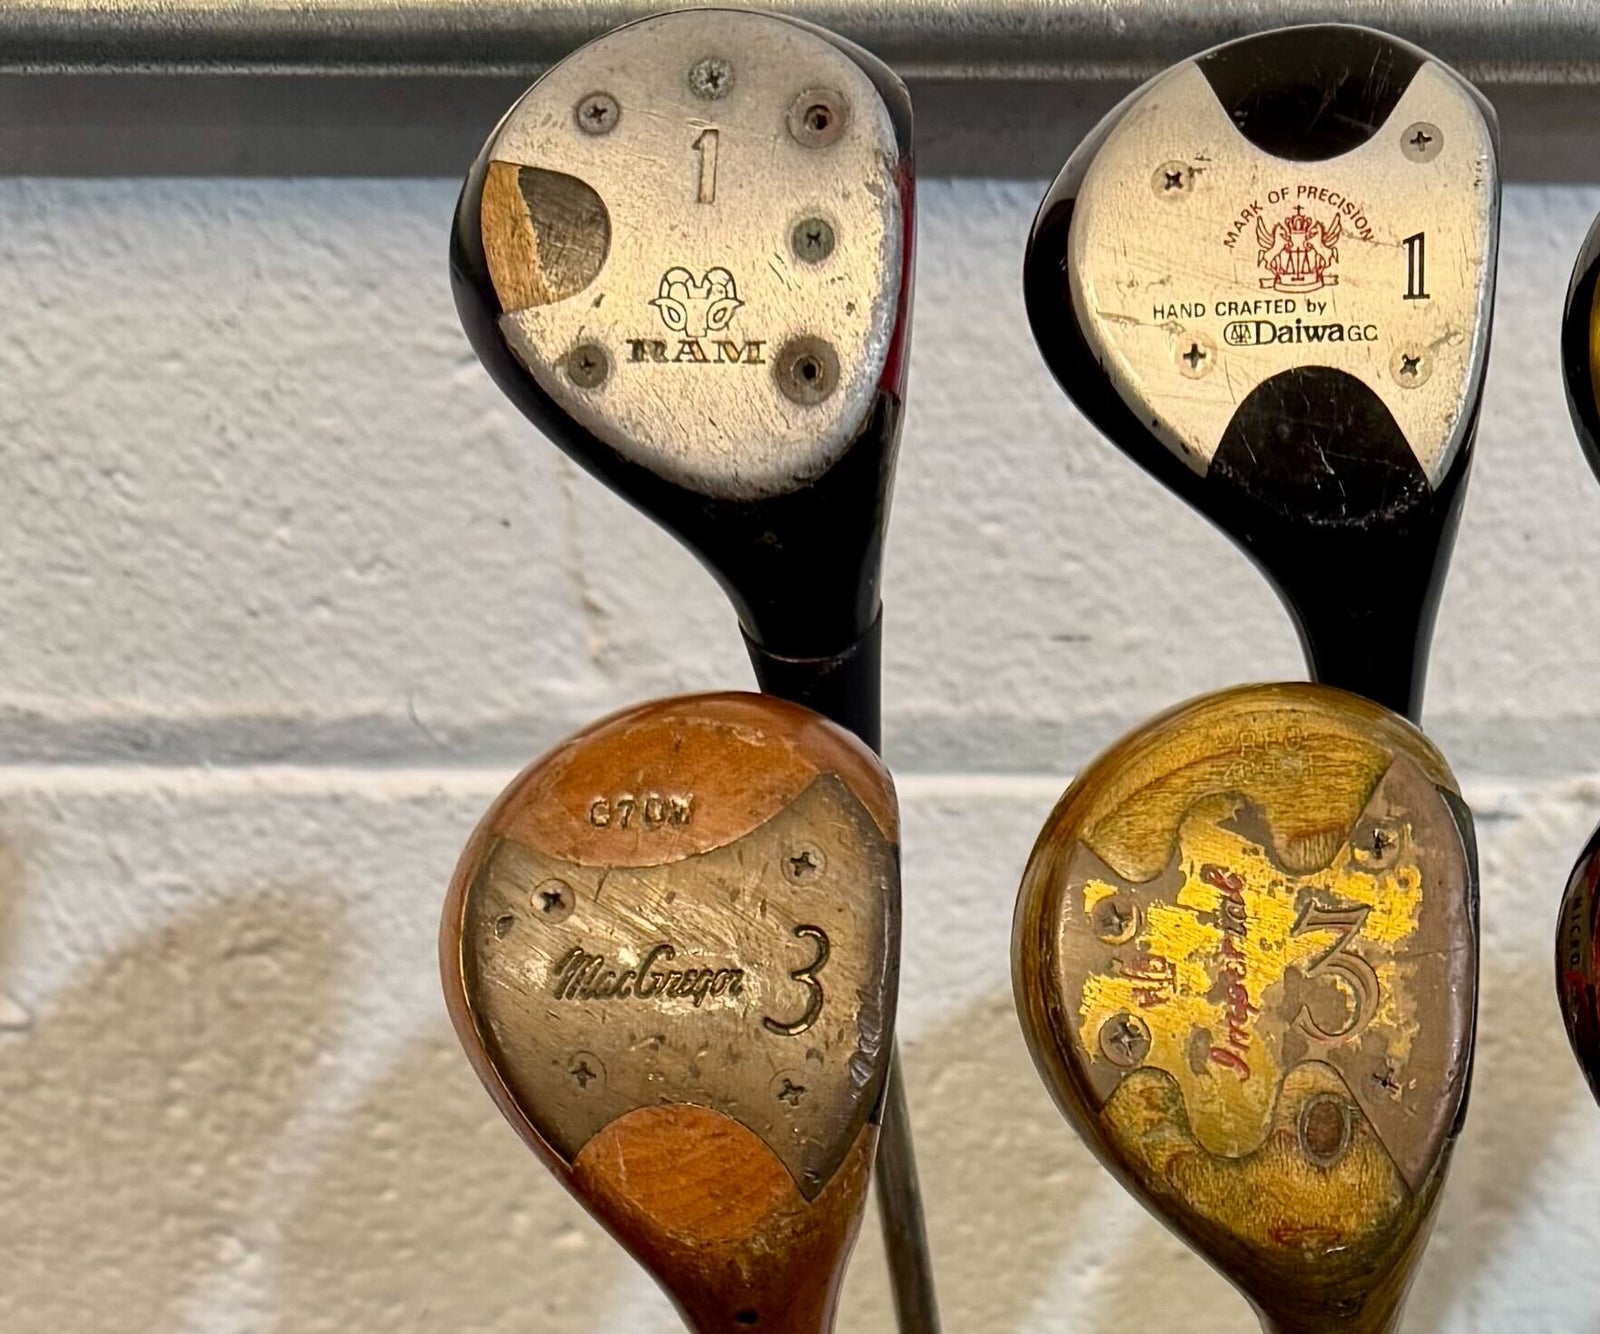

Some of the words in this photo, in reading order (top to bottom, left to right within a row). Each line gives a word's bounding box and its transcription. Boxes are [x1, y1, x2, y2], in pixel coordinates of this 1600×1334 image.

[694, 128, 720, 204] 1
[1223, 199, 1263, 249] MARK
[1267, 187, 1290, 205] OF
[1296, 185, 1375, 243] PRECISION
[1402, 231, 1431, 300] 1
[1153, 303, 1206, 319] HAND
[1214, 299, 1297, 316] CRAFTED
[1306, 300, 1328, 316] by
[1255, 318, 1345, 345] Daiwa
[626, 338, 767, 365] RAM
[552, 944, 745, 1008] MacGregor
[762, 924, 831, 1037] 3
[1290, 898, 1380, 1043] 3
